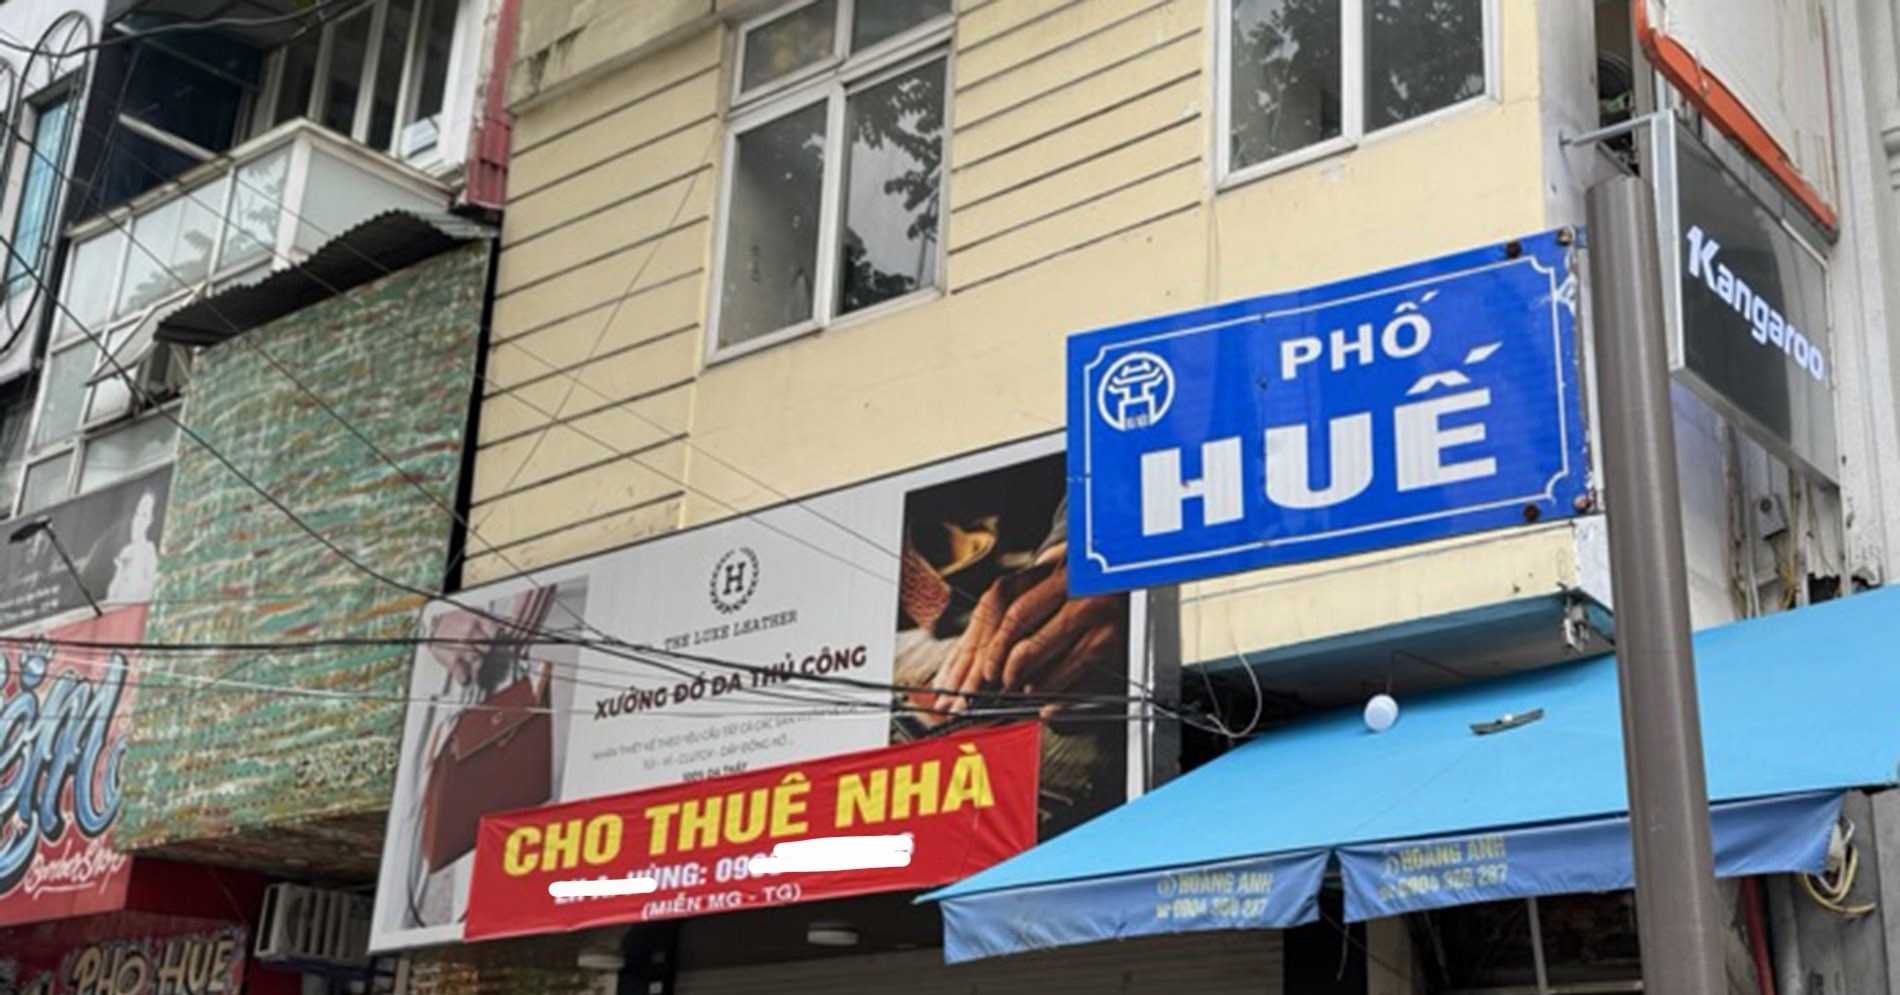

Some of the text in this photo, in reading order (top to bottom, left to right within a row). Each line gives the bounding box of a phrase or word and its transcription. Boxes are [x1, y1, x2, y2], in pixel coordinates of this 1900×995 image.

[1686, 224, 1826, 381] Kangaroo
[1280, 290, 1440, 381] PHỐ
[1139, 342, 1504, 537] HUẾ
[722, 562, 747, 596] H
[733, 609, 799, 637] LEATHER
[801, 645, 868, 676] CÔNG
[503, 812, 625, 876] CHO
[643, 772, 811, 857] THUÊ
[832, 744, 995, 829] NHÀ
[707, 890, 742, 909] MG
[763, 883, 802, 902] TG)
